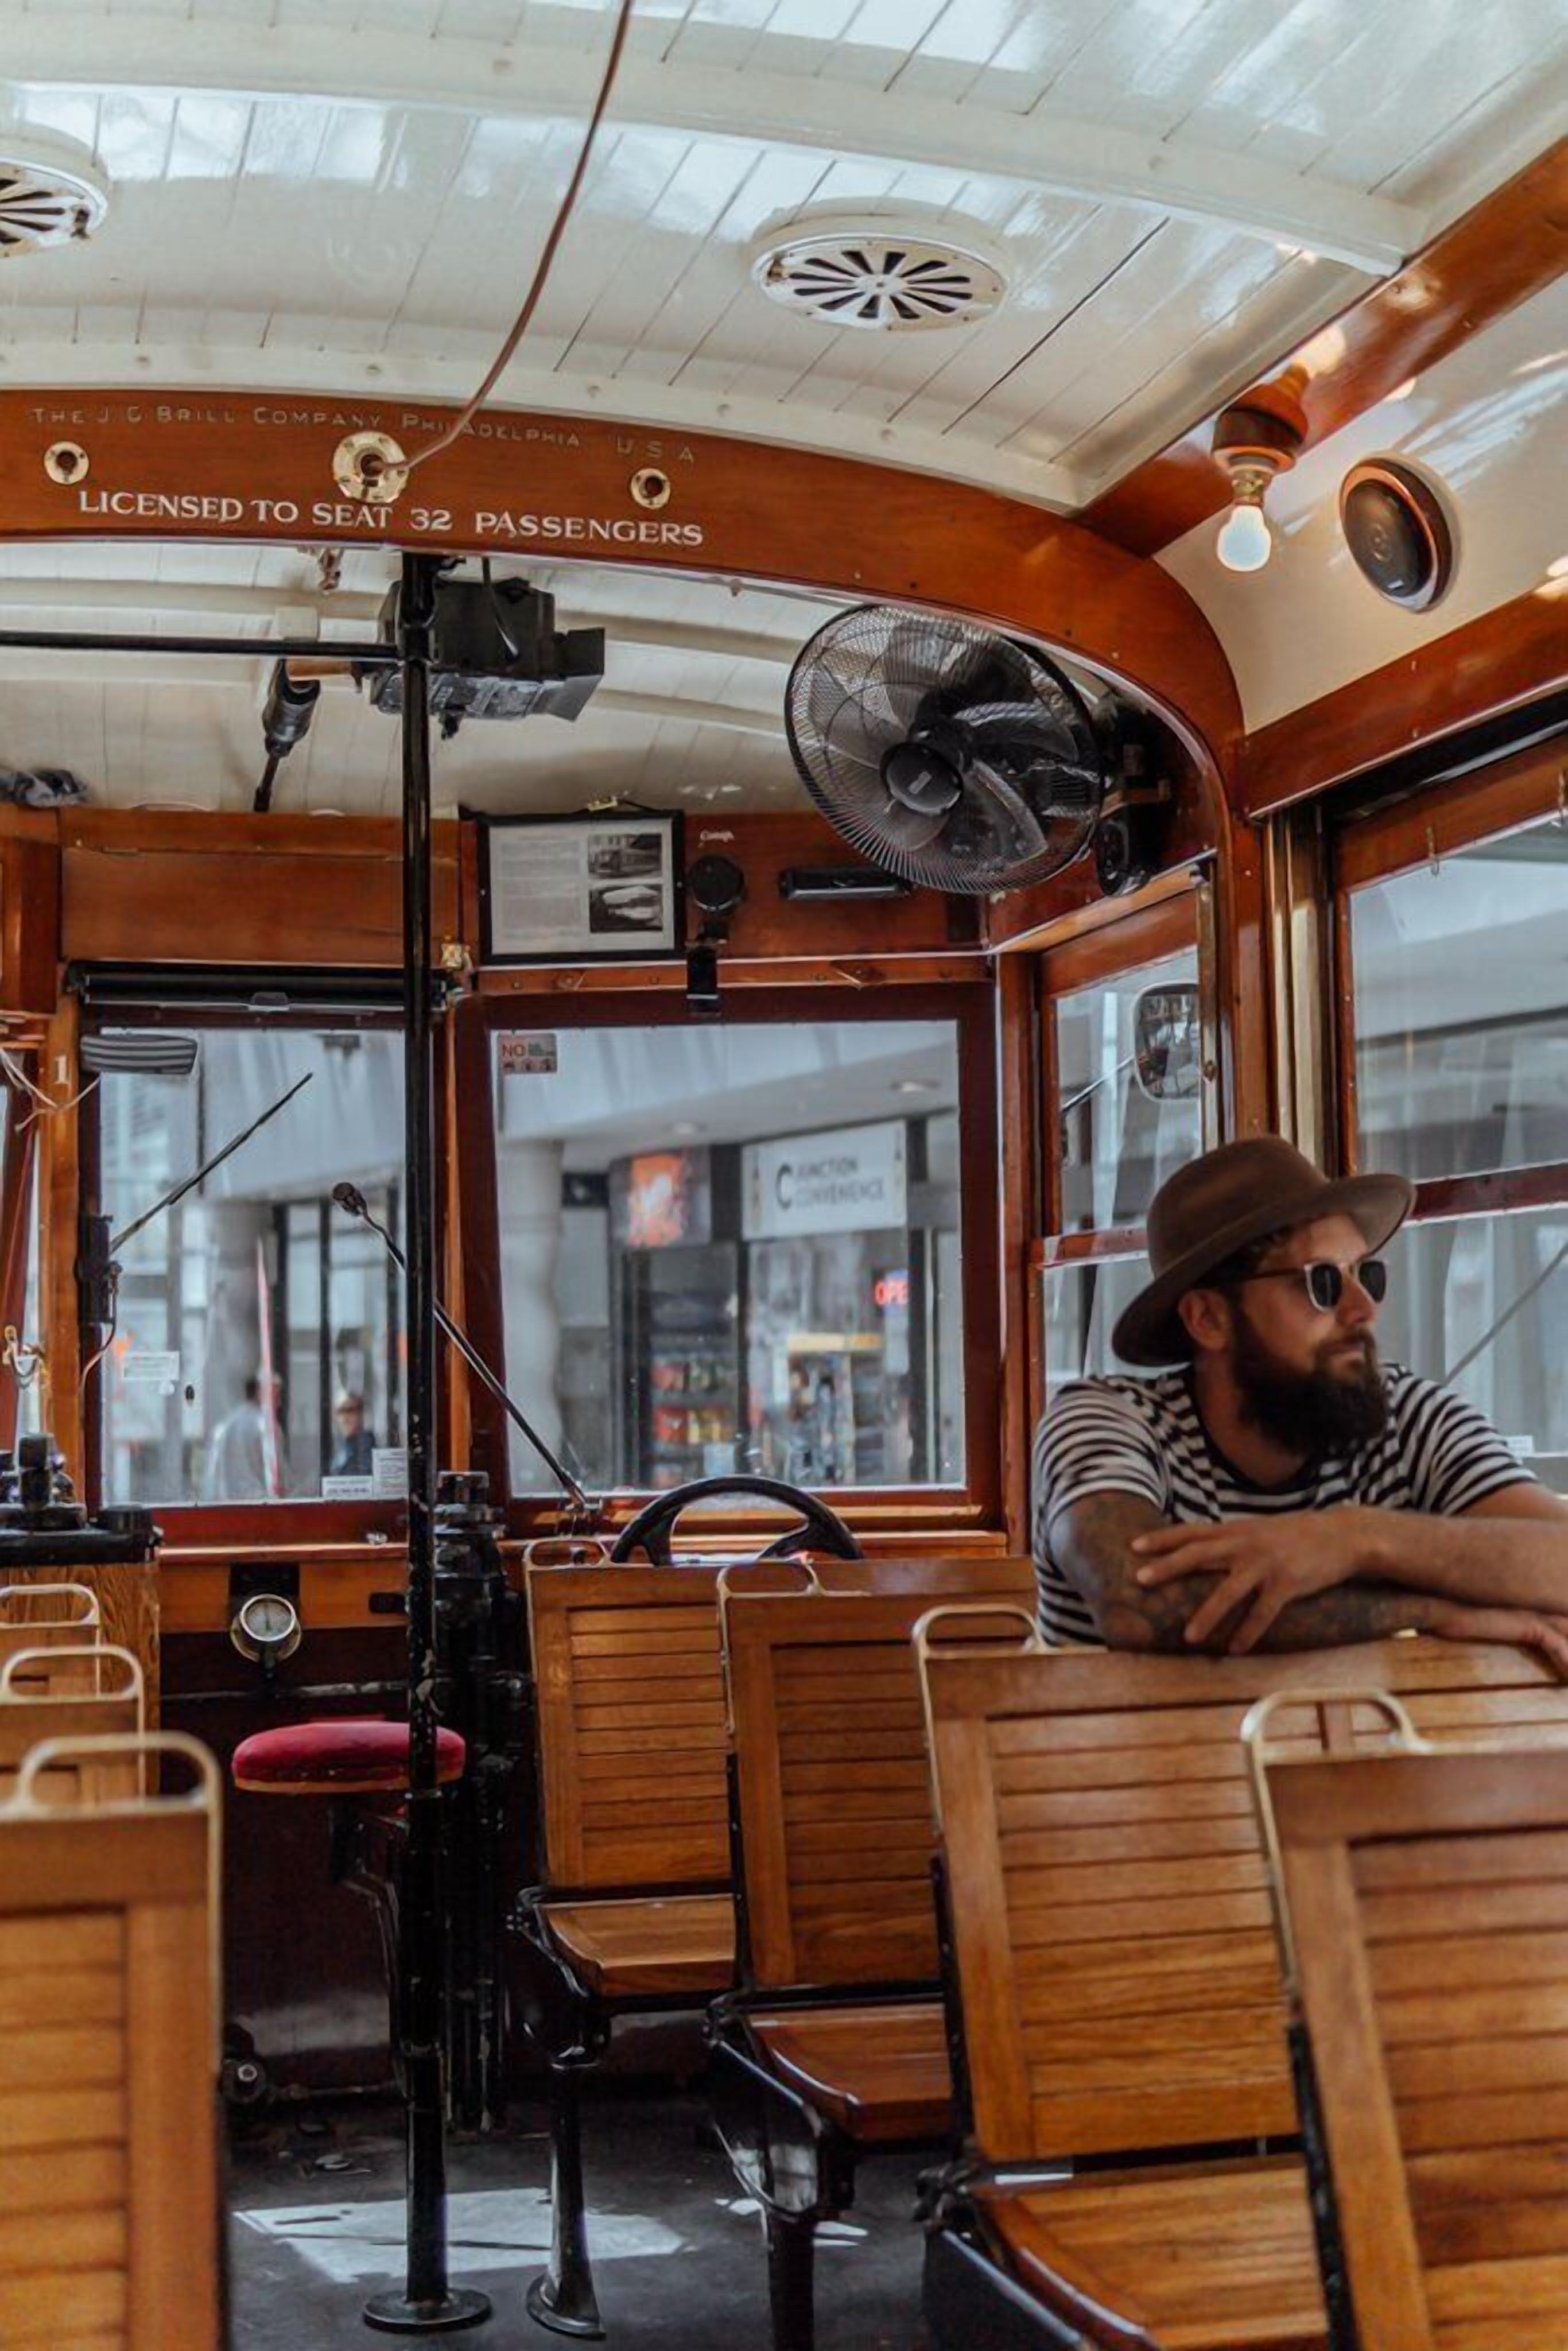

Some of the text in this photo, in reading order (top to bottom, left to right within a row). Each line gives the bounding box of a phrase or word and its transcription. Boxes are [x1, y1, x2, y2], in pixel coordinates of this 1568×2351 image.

[33, 408, 84, 424] THE
[97, 406, 109, 424] J
[157, 405, 235, 424] BRILL
[254, 406, 381, 428] COMPANY
[79, 490, 704, 547] LICENSED TO SEAT 32 PASSENGERS
